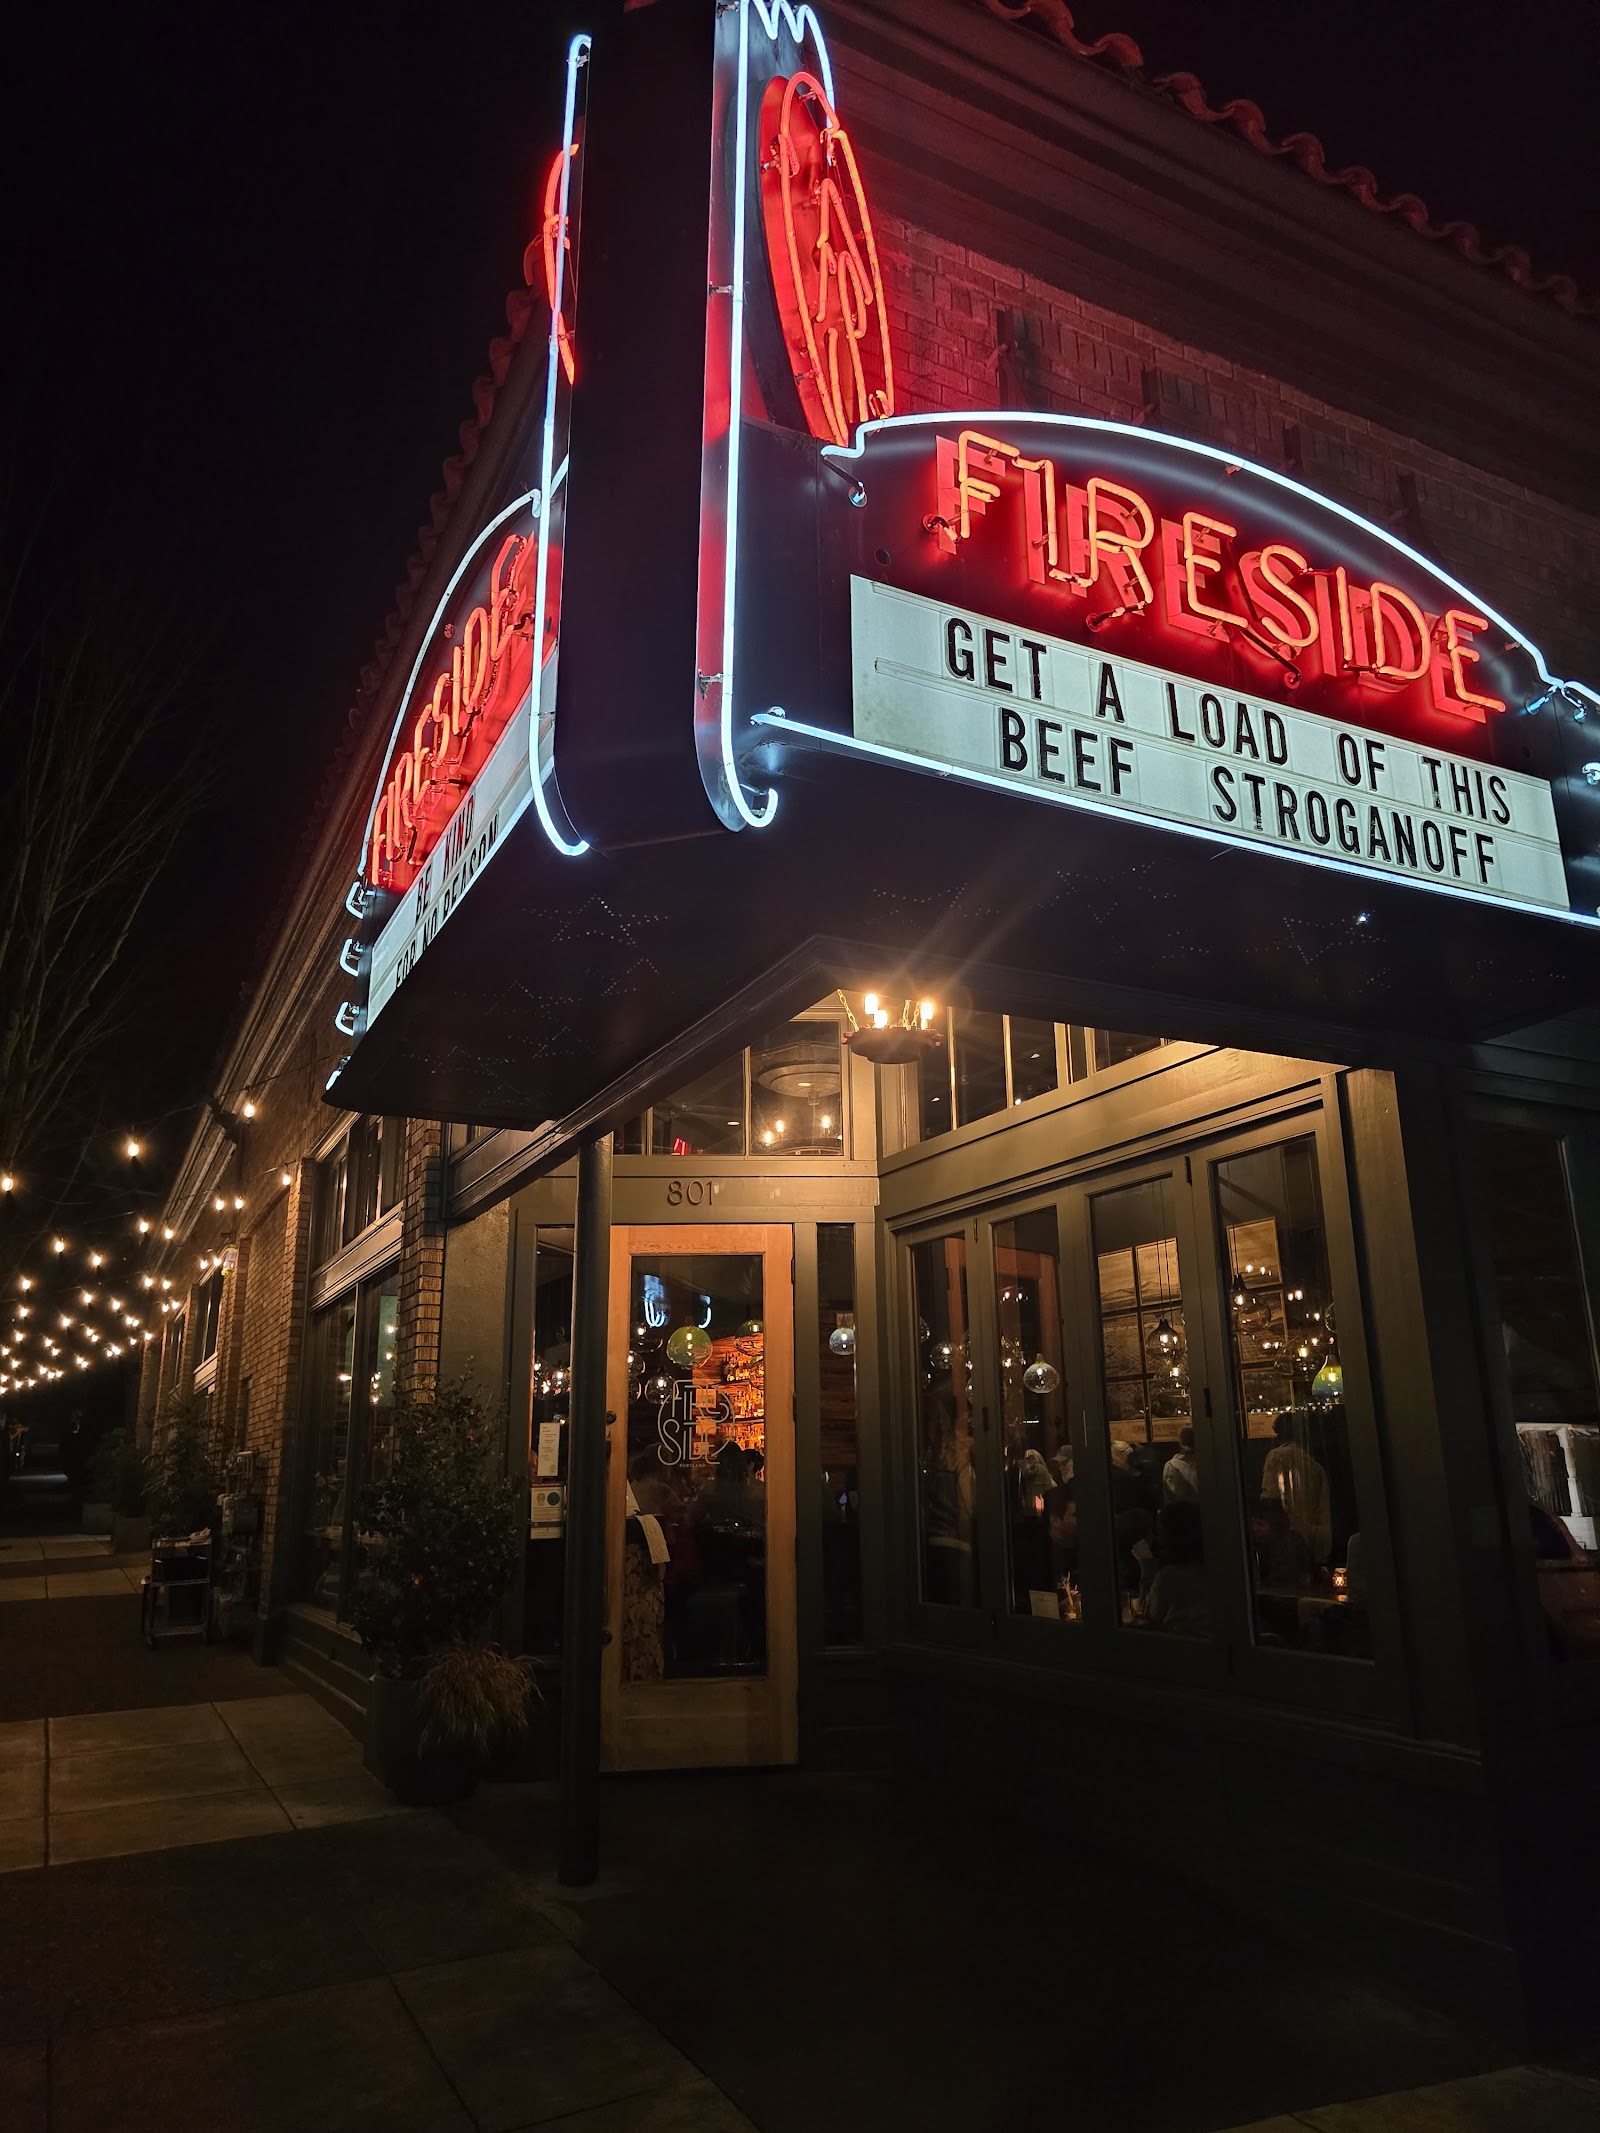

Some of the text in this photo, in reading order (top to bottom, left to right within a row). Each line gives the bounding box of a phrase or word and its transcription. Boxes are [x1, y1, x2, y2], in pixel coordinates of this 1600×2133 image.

[934, 430, 1507, 723] FIRESIDE
[945, 617, 1512, 826] GET A LOAD OF THIS
[999, 707, 1496, 885] BEEF STROGANOFF
[414, 794, 475, 927] BE KIND
[667, 1180, 714, 1206] 801
